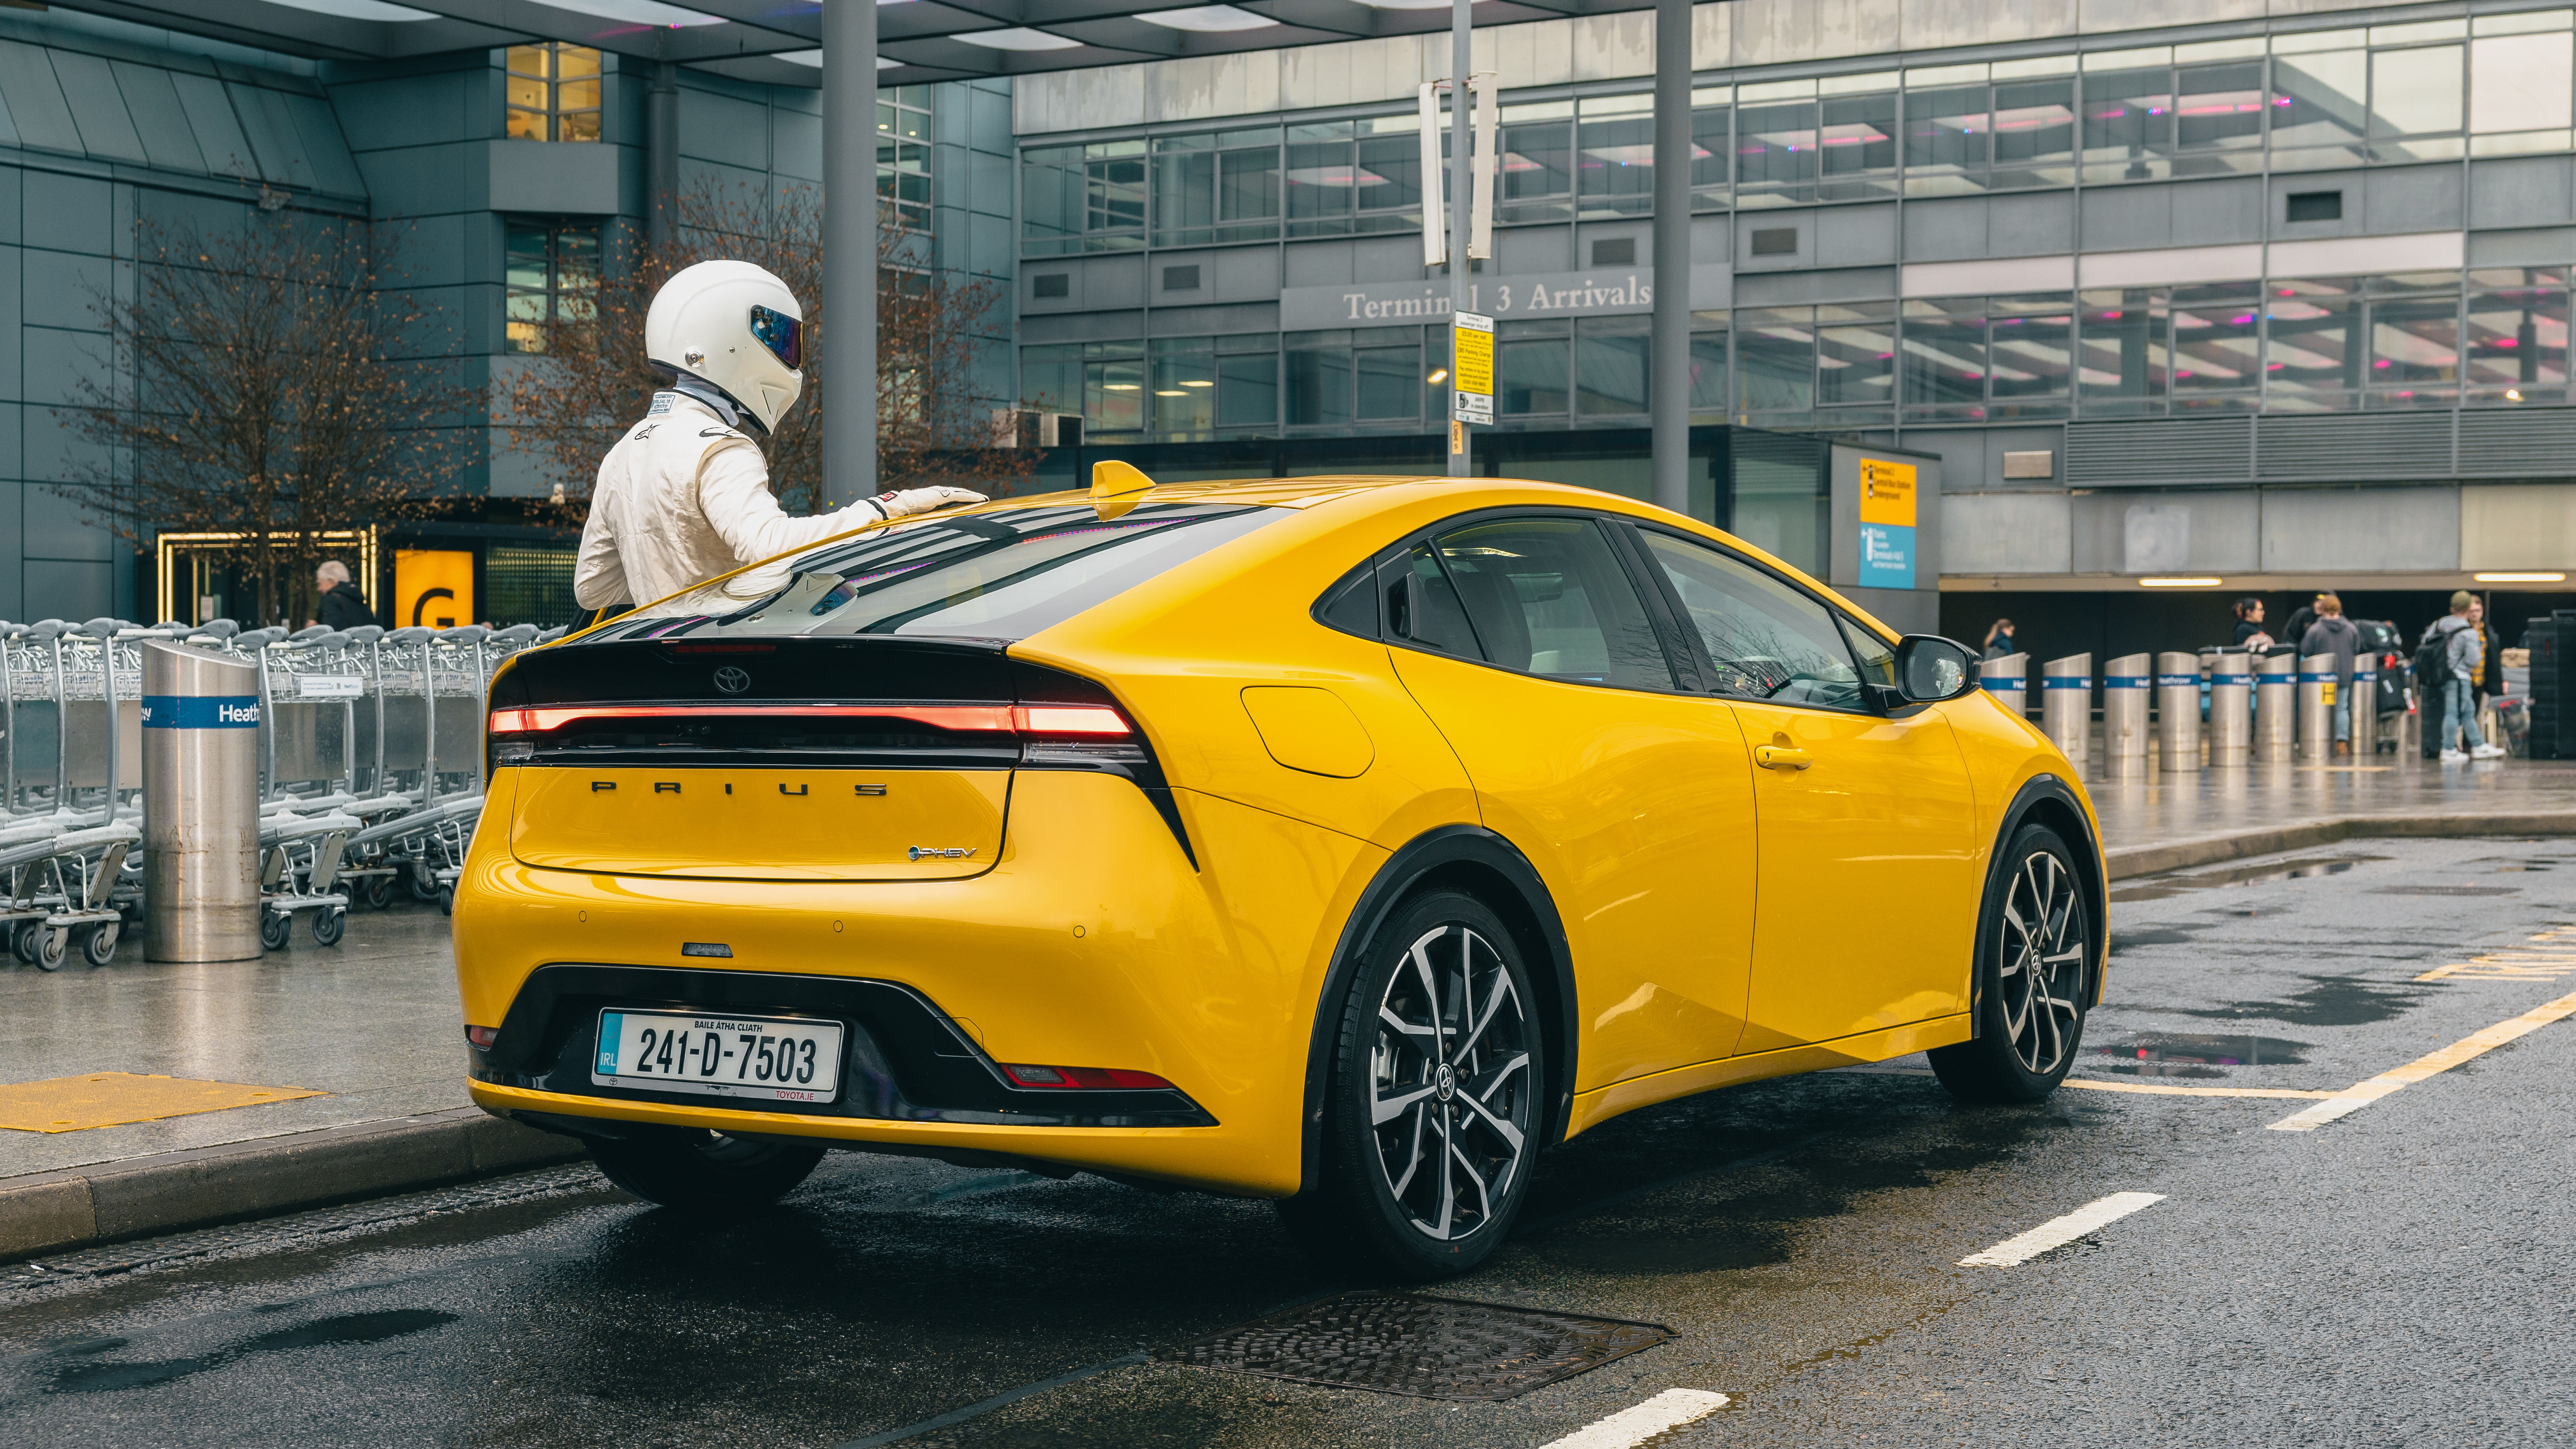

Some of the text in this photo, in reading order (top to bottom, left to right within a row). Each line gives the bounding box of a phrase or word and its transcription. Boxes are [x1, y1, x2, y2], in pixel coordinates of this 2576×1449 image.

[1343, 276, 1652, 320] Terminl 3 Arrivals
[413, 587, 455, 627] G
[591, 781, 887, 797] PRIUS
[920, 848, 977, 858] PHEV
[694, 1020, 763, 1033] BAILE ÁTHA CLIATH
[600, 1051, 617, 1067] IRL
[637, 1028, 817, 1084] 241-D-7503
[776, 1090, 814, 1102] TOYOTA.IE
